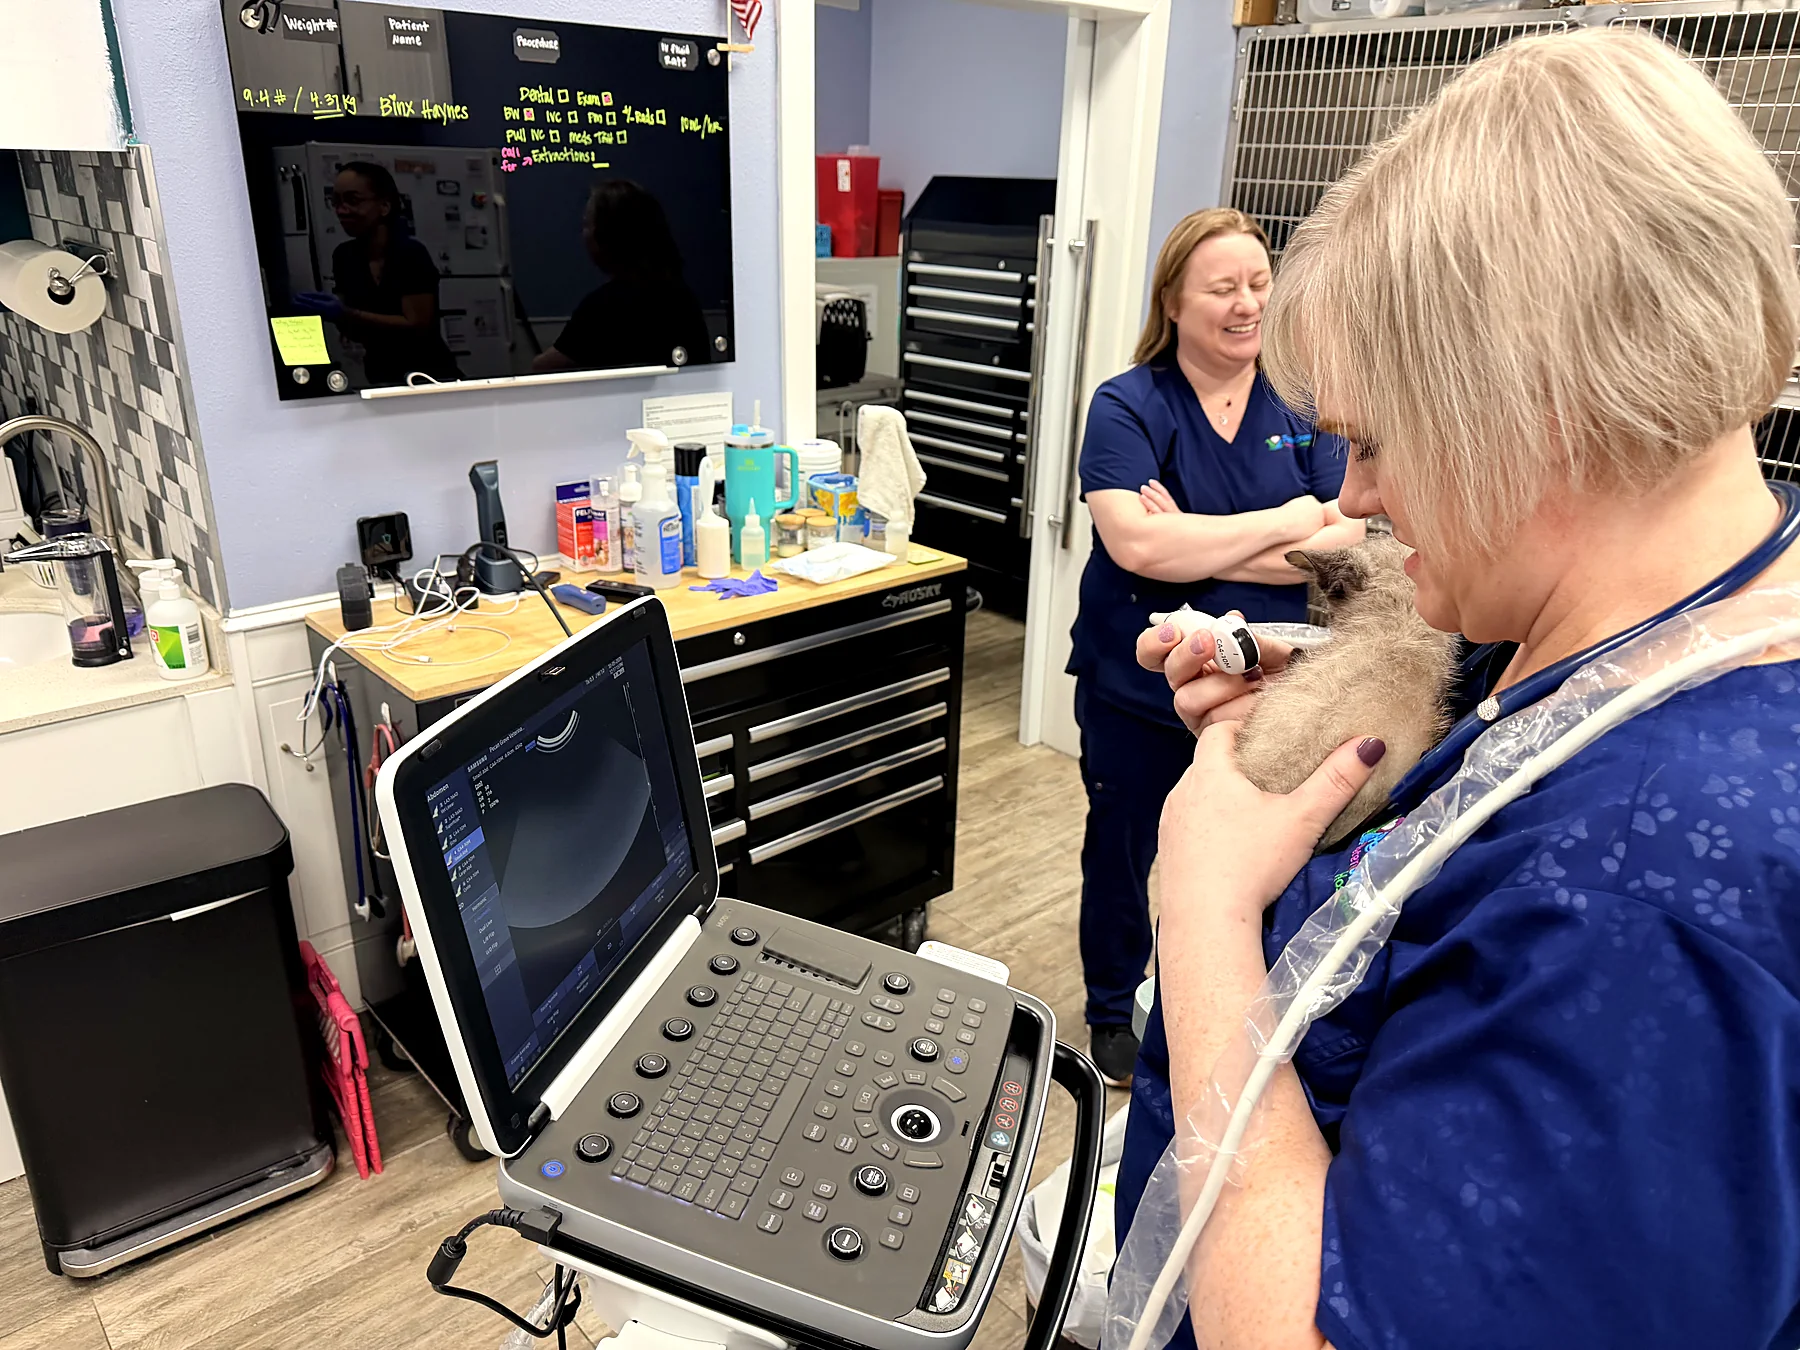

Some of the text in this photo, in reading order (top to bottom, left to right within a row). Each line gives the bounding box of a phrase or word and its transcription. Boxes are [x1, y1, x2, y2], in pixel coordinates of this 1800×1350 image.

[283, 14, 338, 35] Weight#
[388, 17, 430, 32] Patient
[392, 34, 422, 47] Name
[516, 35, 559, 50] Procedure
[664, 56, 687, 67] Rate
[519, 85, 601, 106] Dental Exam
[243, 88, 270, 108] 9.4
[379, 94, 415, 117] Binx
[422, 99, 469, 126] Haynes
[503, 106, 520, 121] BW
[899, 583, 942, 605] HUSKY
[467, 754, 487, 772] SAMSUNG
[427, 782, 448, 801] Abdomen
[776, 1192, 786, 1204] Probe
[765, 1214, 775, 1228] Patient
